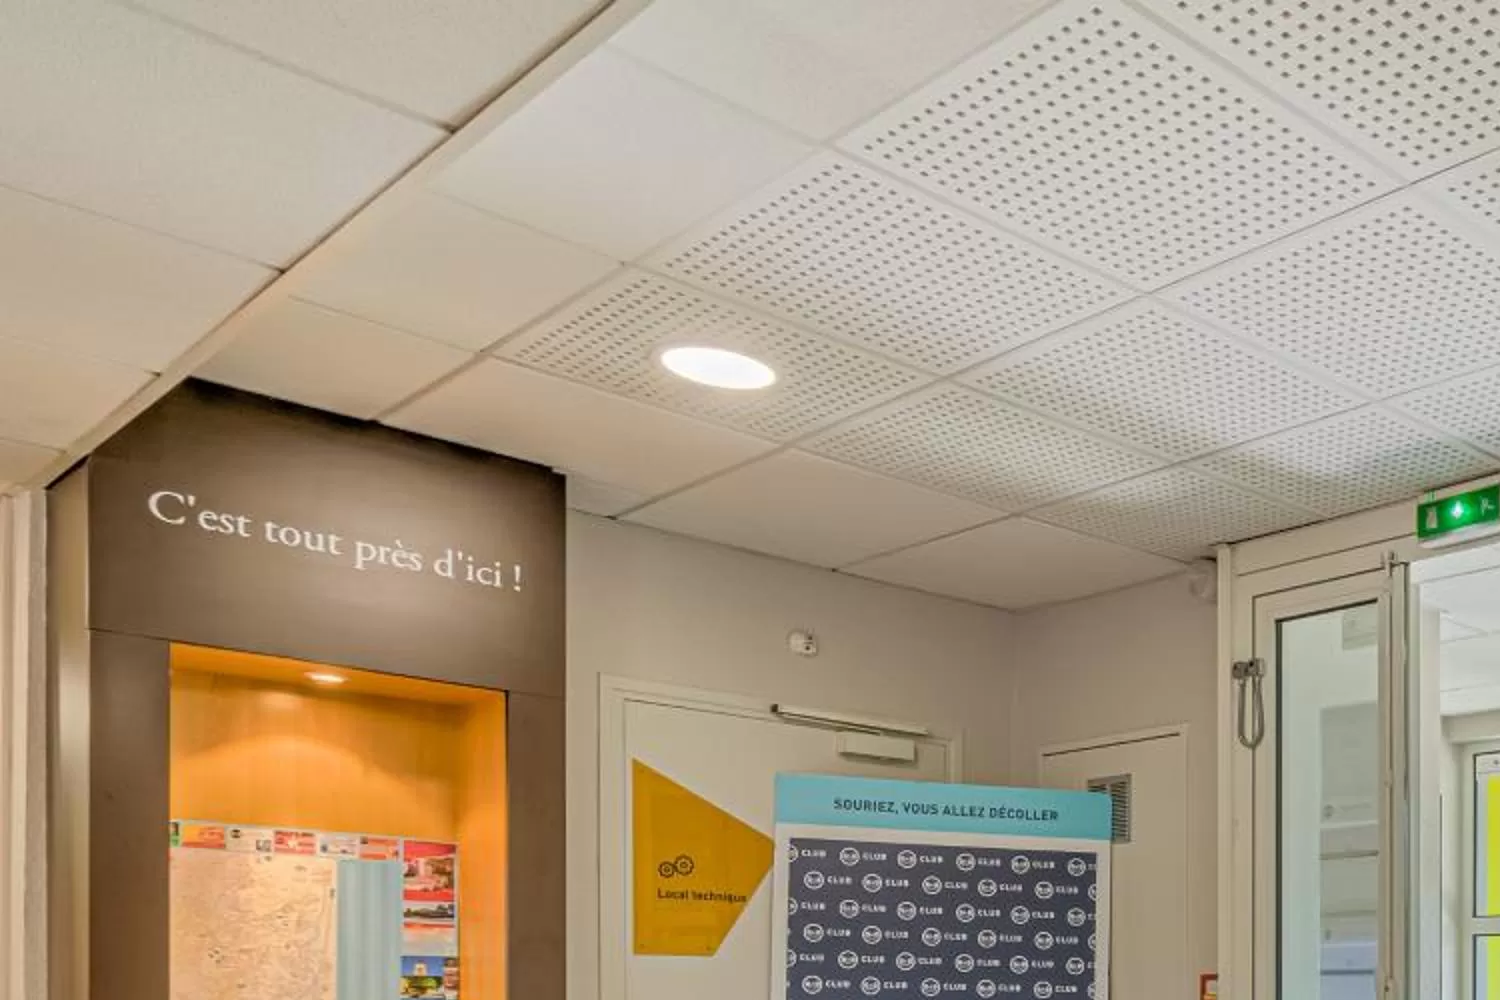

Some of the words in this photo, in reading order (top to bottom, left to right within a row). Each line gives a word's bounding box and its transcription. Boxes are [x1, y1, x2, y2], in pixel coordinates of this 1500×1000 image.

[149, 491, 252, 537] C'est
[265, 519, 342, 555] tout
[355, 540, 422, 570] près
[434, 549, 502, 588] d'ici
[513, 565, 521, 592] !
[834, 799, 899, 815] SOURIEZ,
[904, 803, 938, 816] VOUS
[942, 804, 984, 819] ALLEZ
[989, 804, 1058, 821] DÉCOLLER
[658, 888, 688, 900] Local
[692, 890, 746, 903] technique
